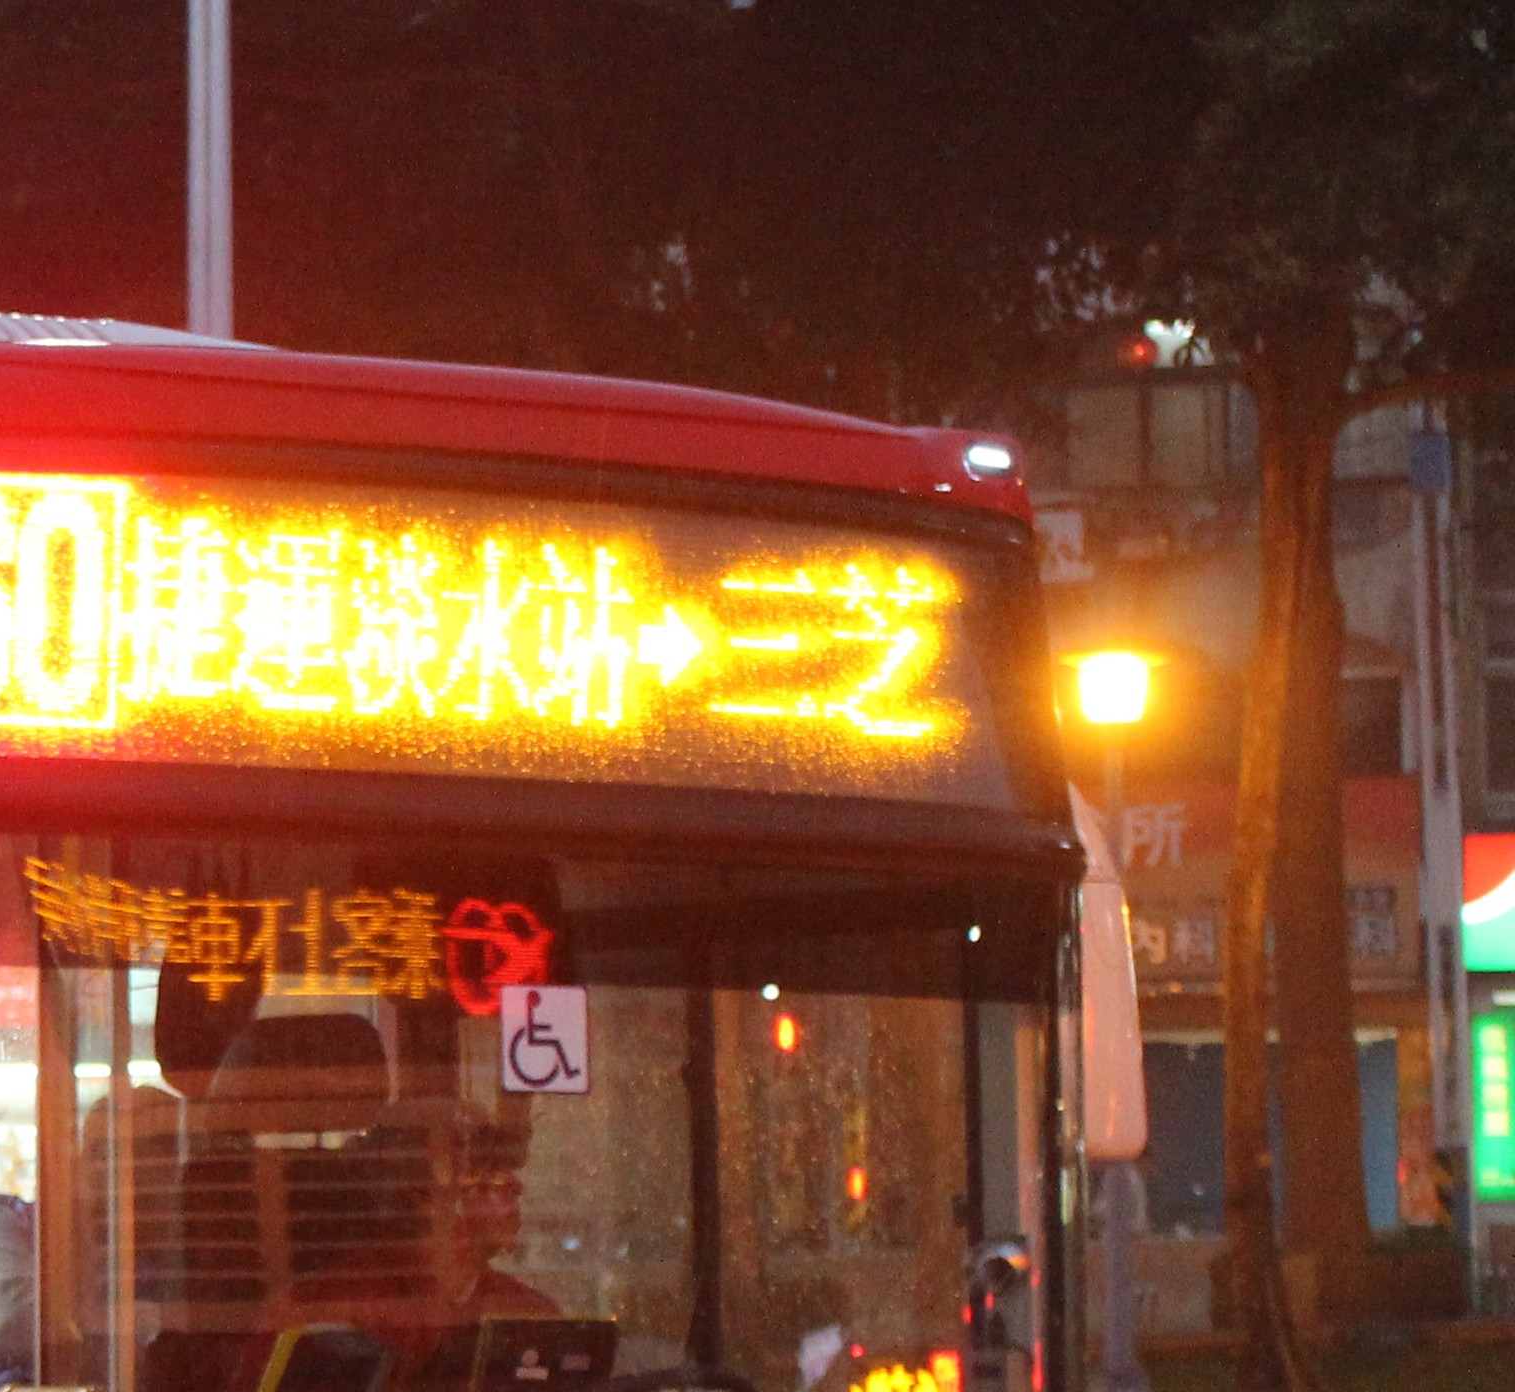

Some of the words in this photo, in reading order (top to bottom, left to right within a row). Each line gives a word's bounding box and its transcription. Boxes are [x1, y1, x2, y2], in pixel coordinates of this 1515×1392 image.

[121, 515, 631, 728] 捷運淡水站
[706, 557, 939, 740] 三芝
